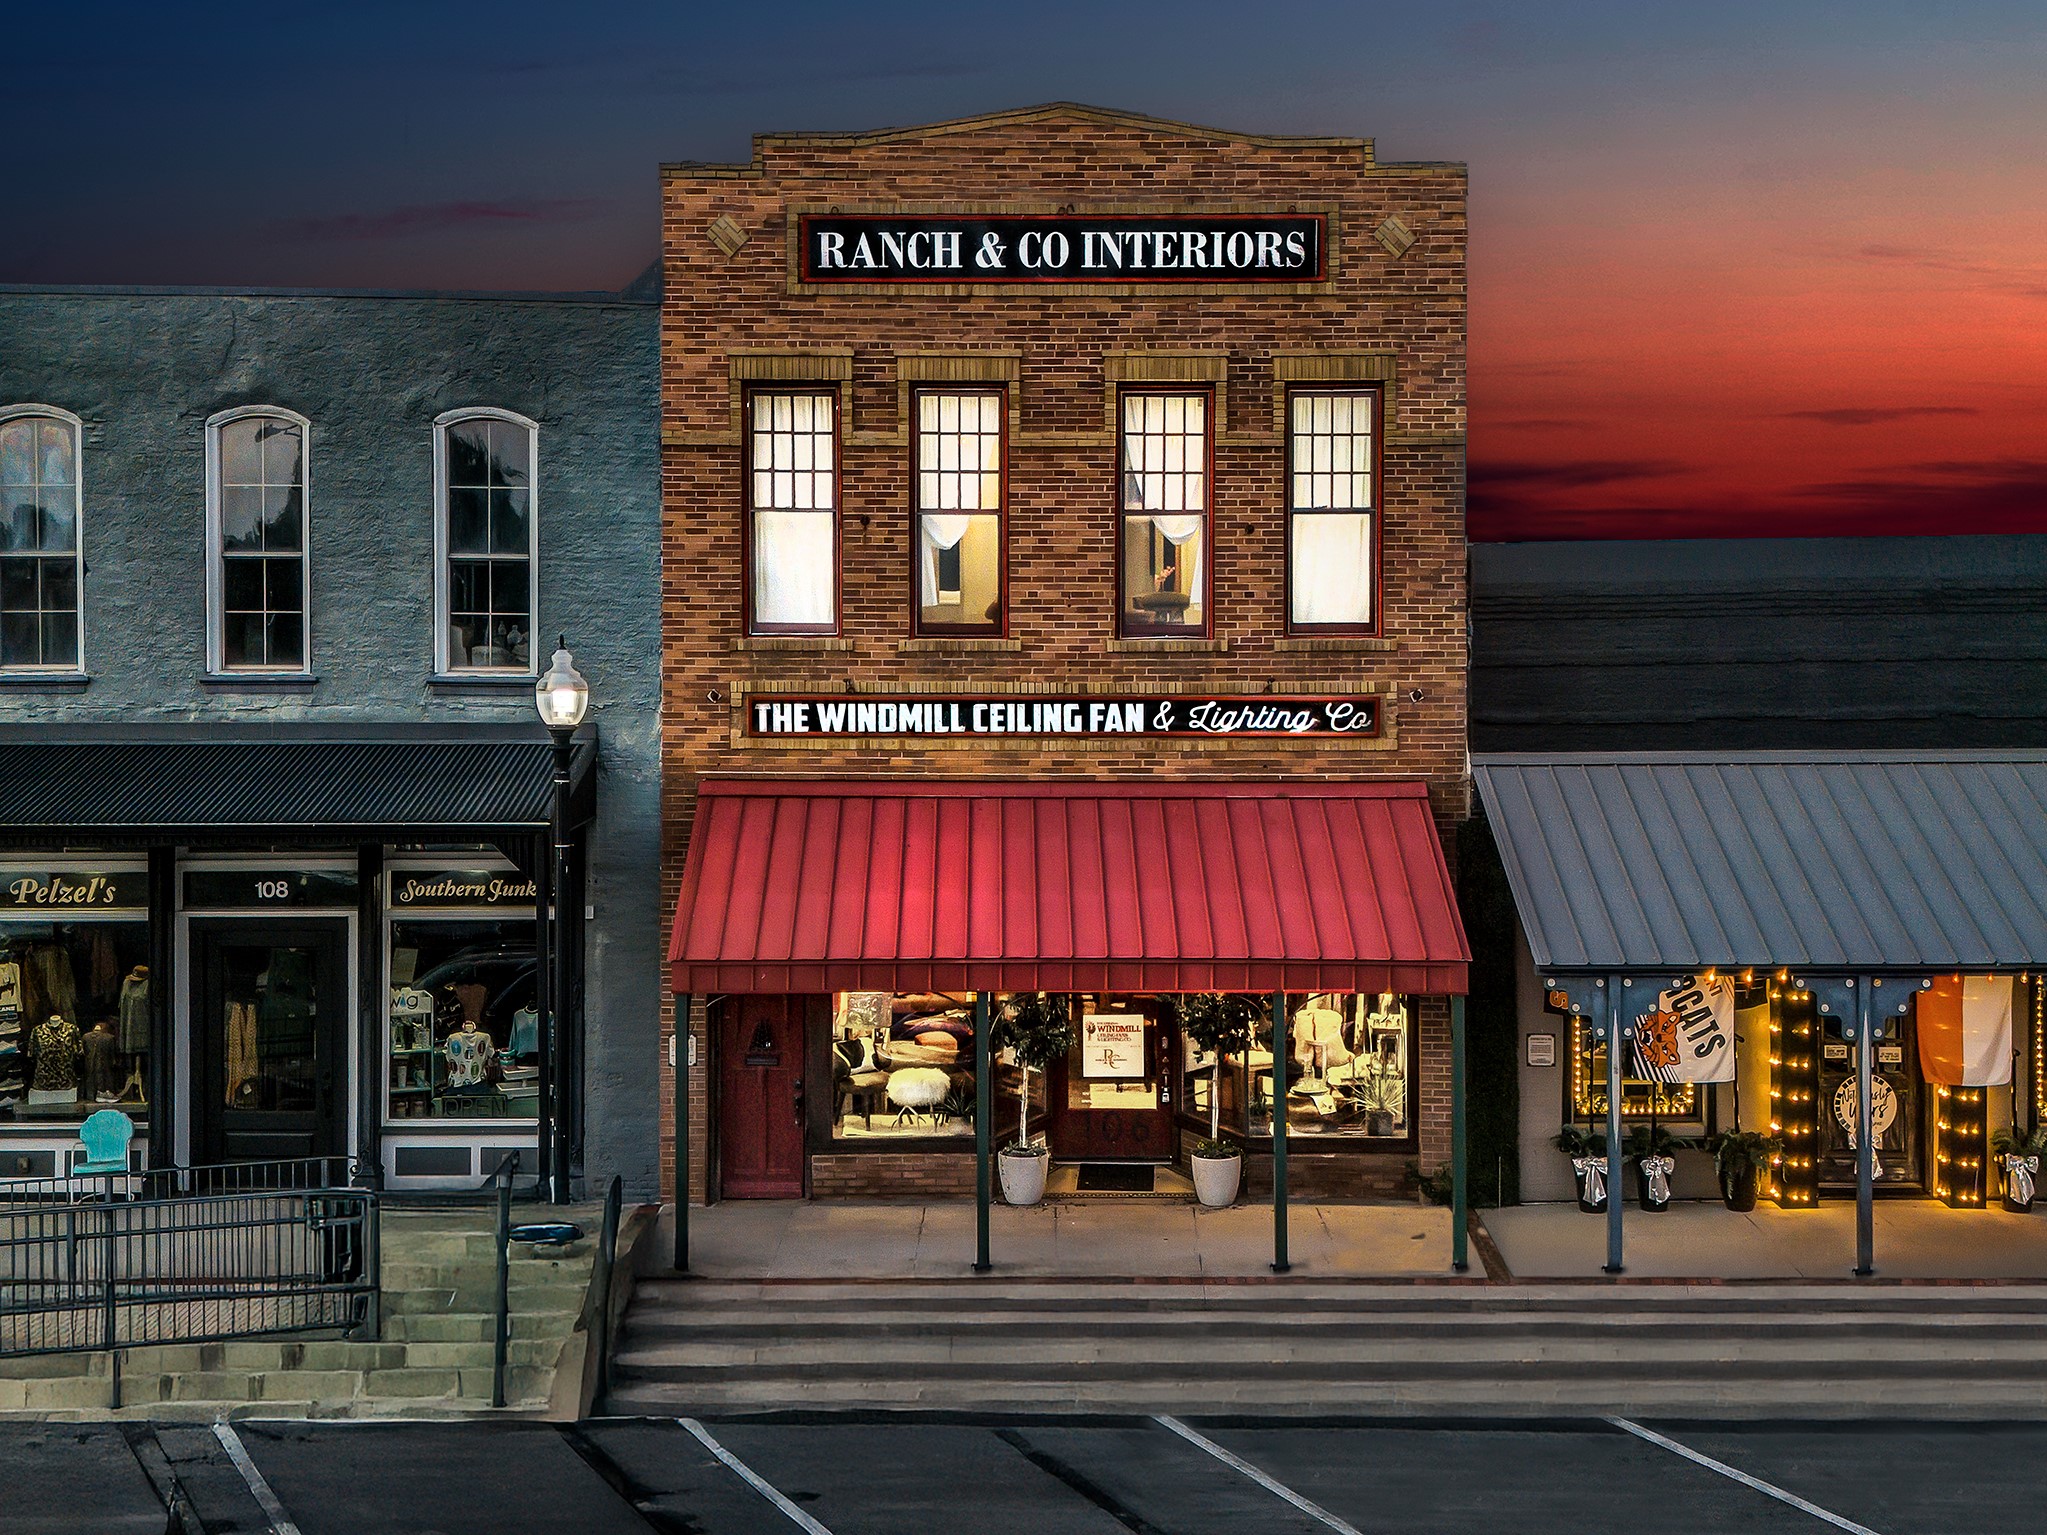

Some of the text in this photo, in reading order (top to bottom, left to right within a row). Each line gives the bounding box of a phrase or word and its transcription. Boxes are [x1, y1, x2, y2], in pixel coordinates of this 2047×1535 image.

[816, 231, 1306, 269] RANCH & CO INTERIORS
[755, 701, 1371, 735] THE WINDMILL CEILING FAN & Lighting Co
[9, 877, 117, 904] Pelzel's
[254, 881, 289, 898] 108
[399, 879, 486, 902] Southern
[1096, 1025, 1142, 1033] WINDMILL
[443, 1097, 506, 1117] OPEN
